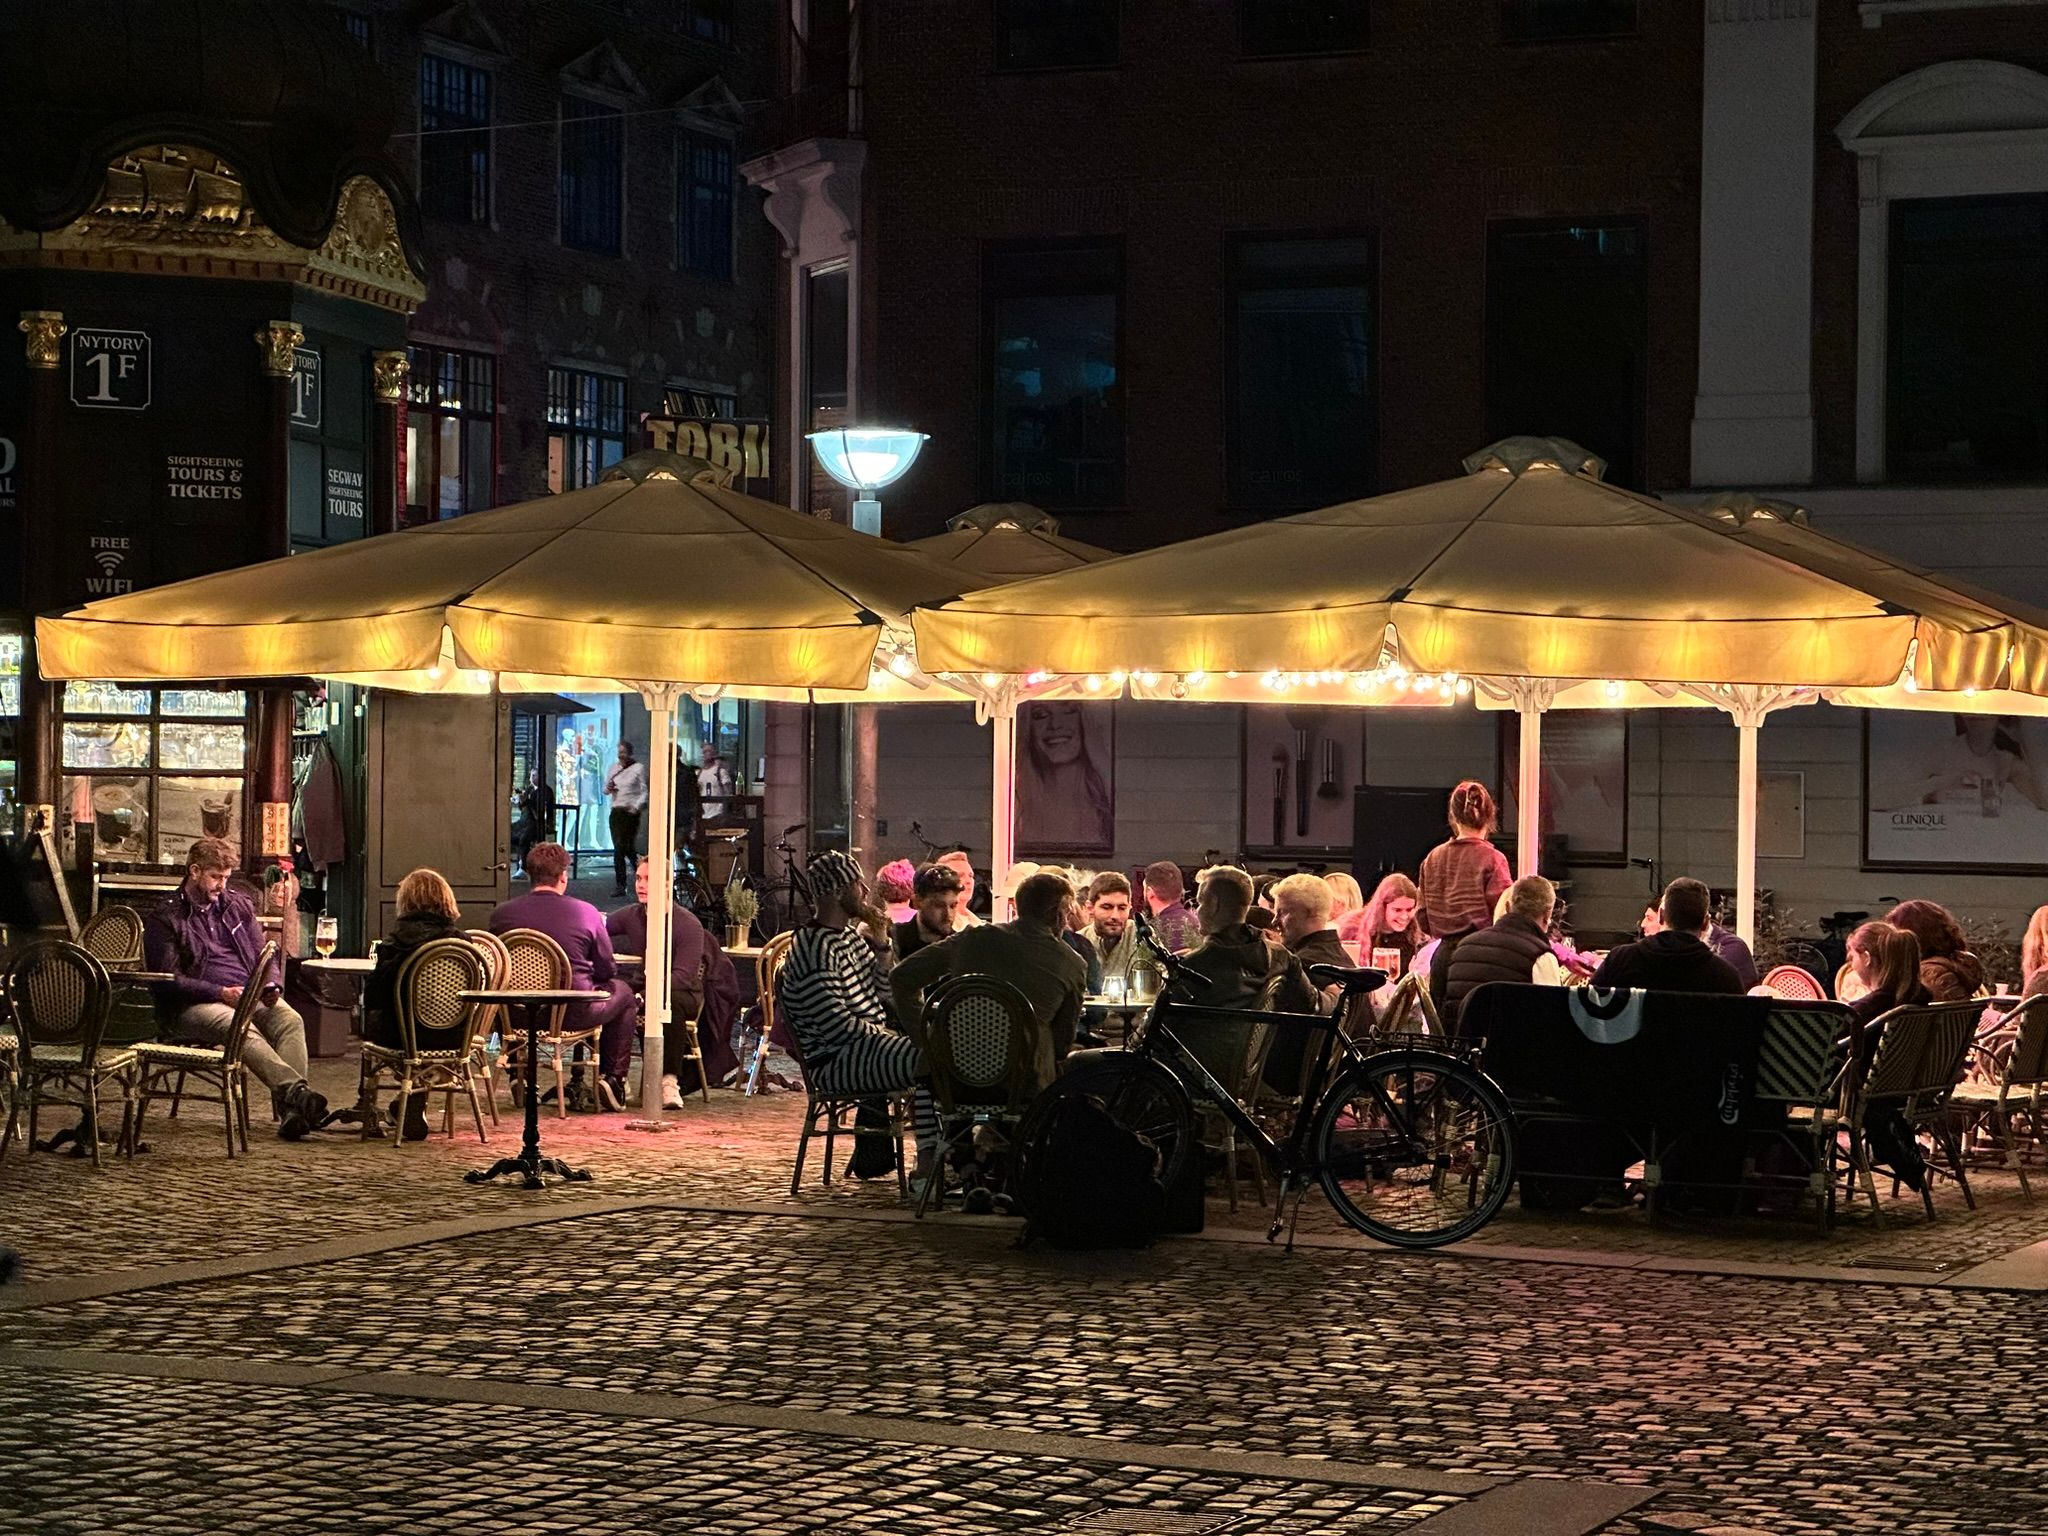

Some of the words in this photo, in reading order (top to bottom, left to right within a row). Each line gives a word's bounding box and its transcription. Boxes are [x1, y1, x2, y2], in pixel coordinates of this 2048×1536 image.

[79, 335, 144, 351] NYTORV
[167, 456, 243, 468] SIGHTSEEING
[167, 467, 225, 482] TOURS
[229, 470, 243, 483] &
[328, 469, 363, 487] SEGWAY
[167, 484, 243, 500] TICKETS
[328, 498, 364, 518] TOURS
[90, 536, 129, 549] FREE
[1891, 814, 1947, 826] CLINIQUE
